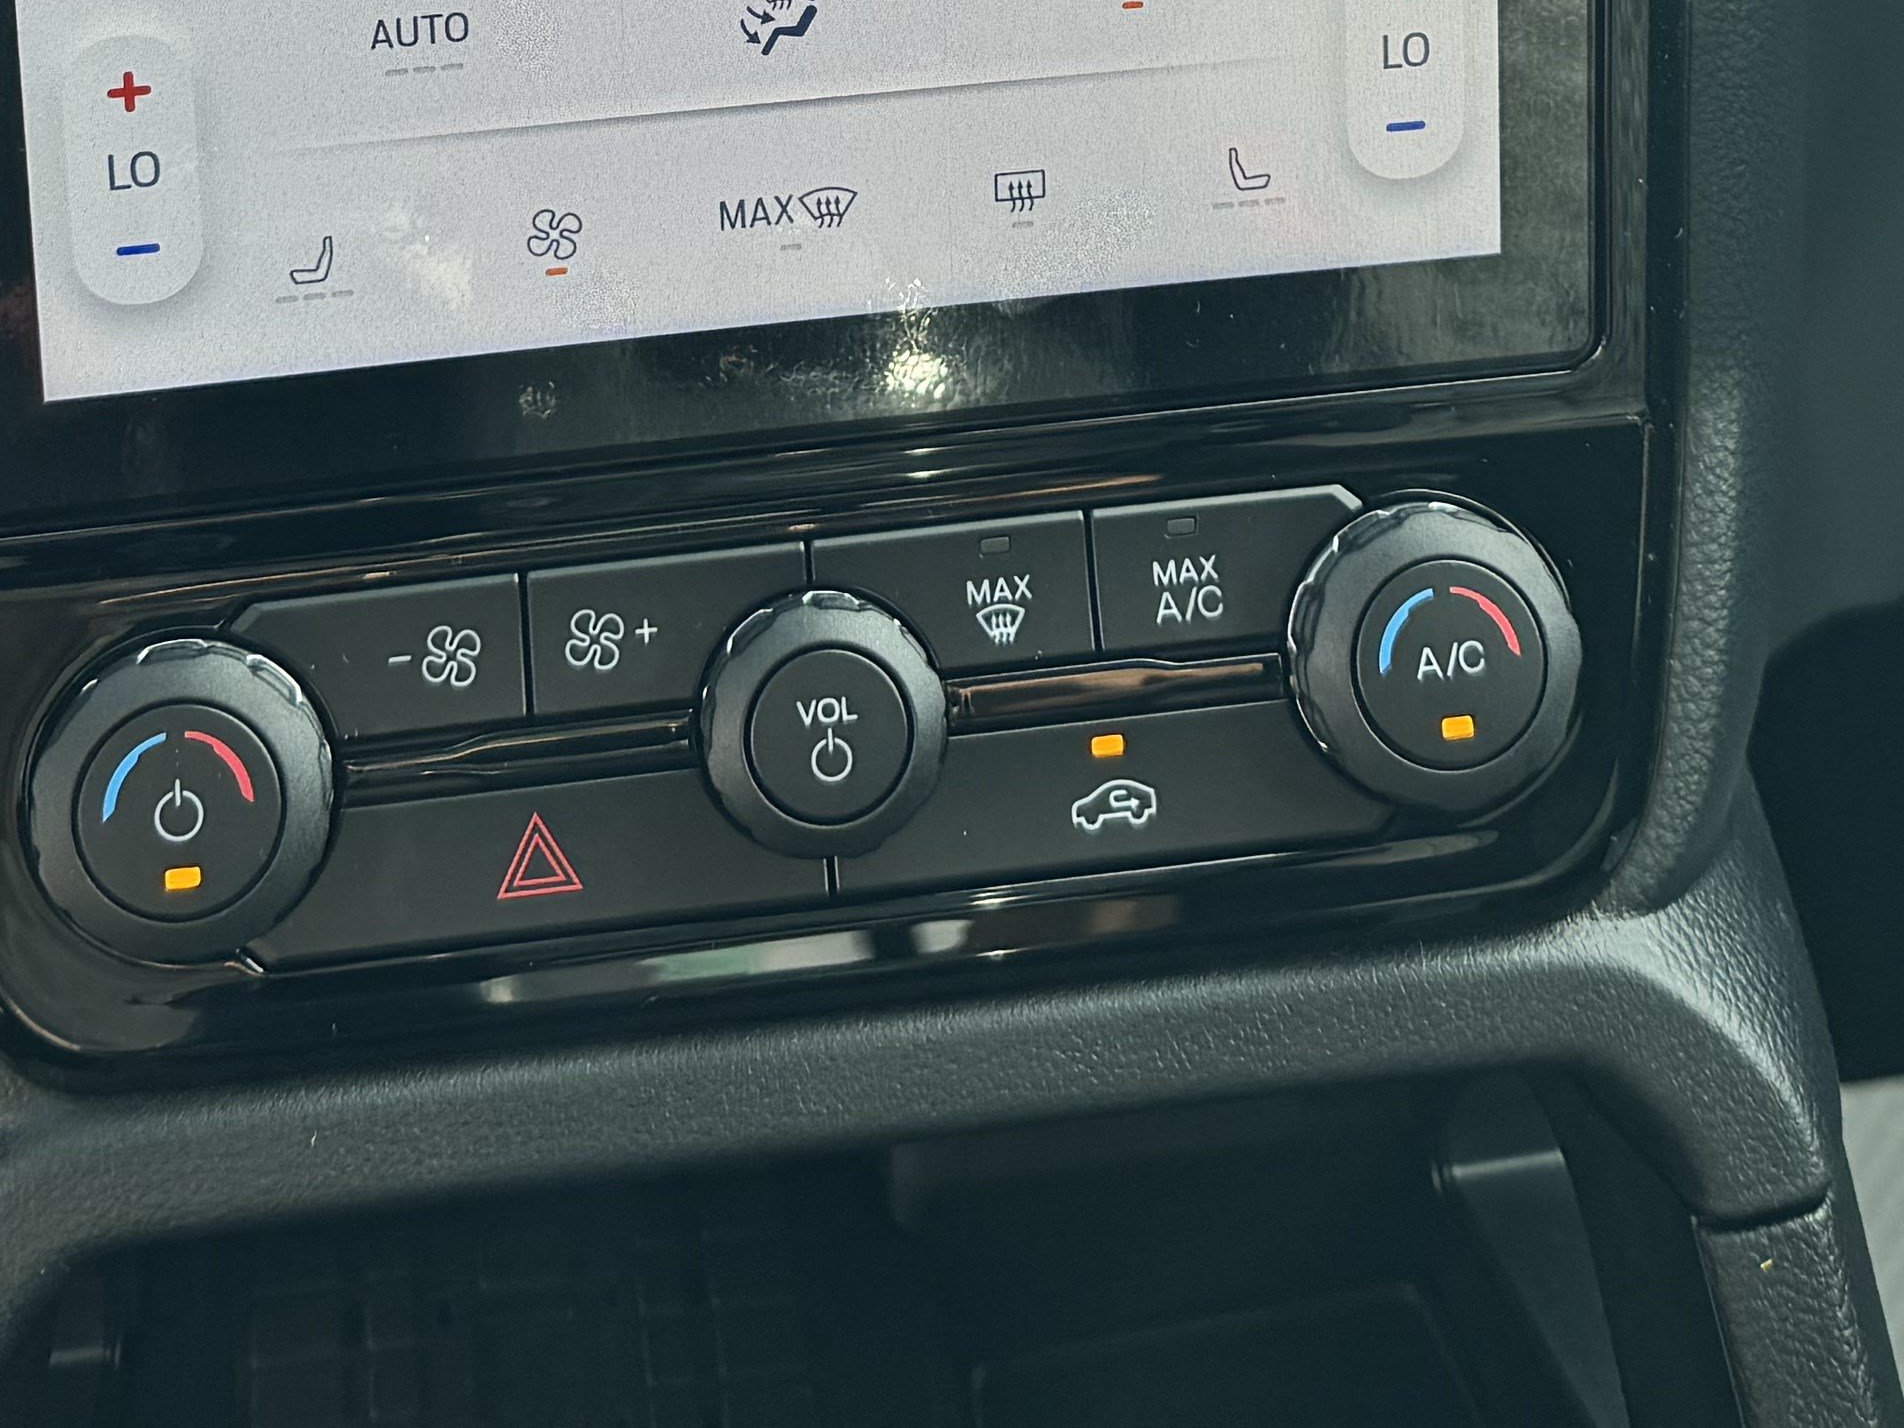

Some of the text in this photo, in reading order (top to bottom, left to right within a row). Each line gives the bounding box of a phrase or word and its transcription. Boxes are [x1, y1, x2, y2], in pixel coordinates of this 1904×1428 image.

[370, 12, 470, 51] AUTO
[1381, 31, 1431, 72] LO
[107, 149, 161, 191] LO
[718, 192, 796, 232] MAX
[966, 574, 1033, 606] MAX
[1151, 553, 1220, 588] MAX
[1154, 584, 1224, 625] A/C
[1415, 640, 1486, 683] A/C
[796, 696, 858, 725] VOL
